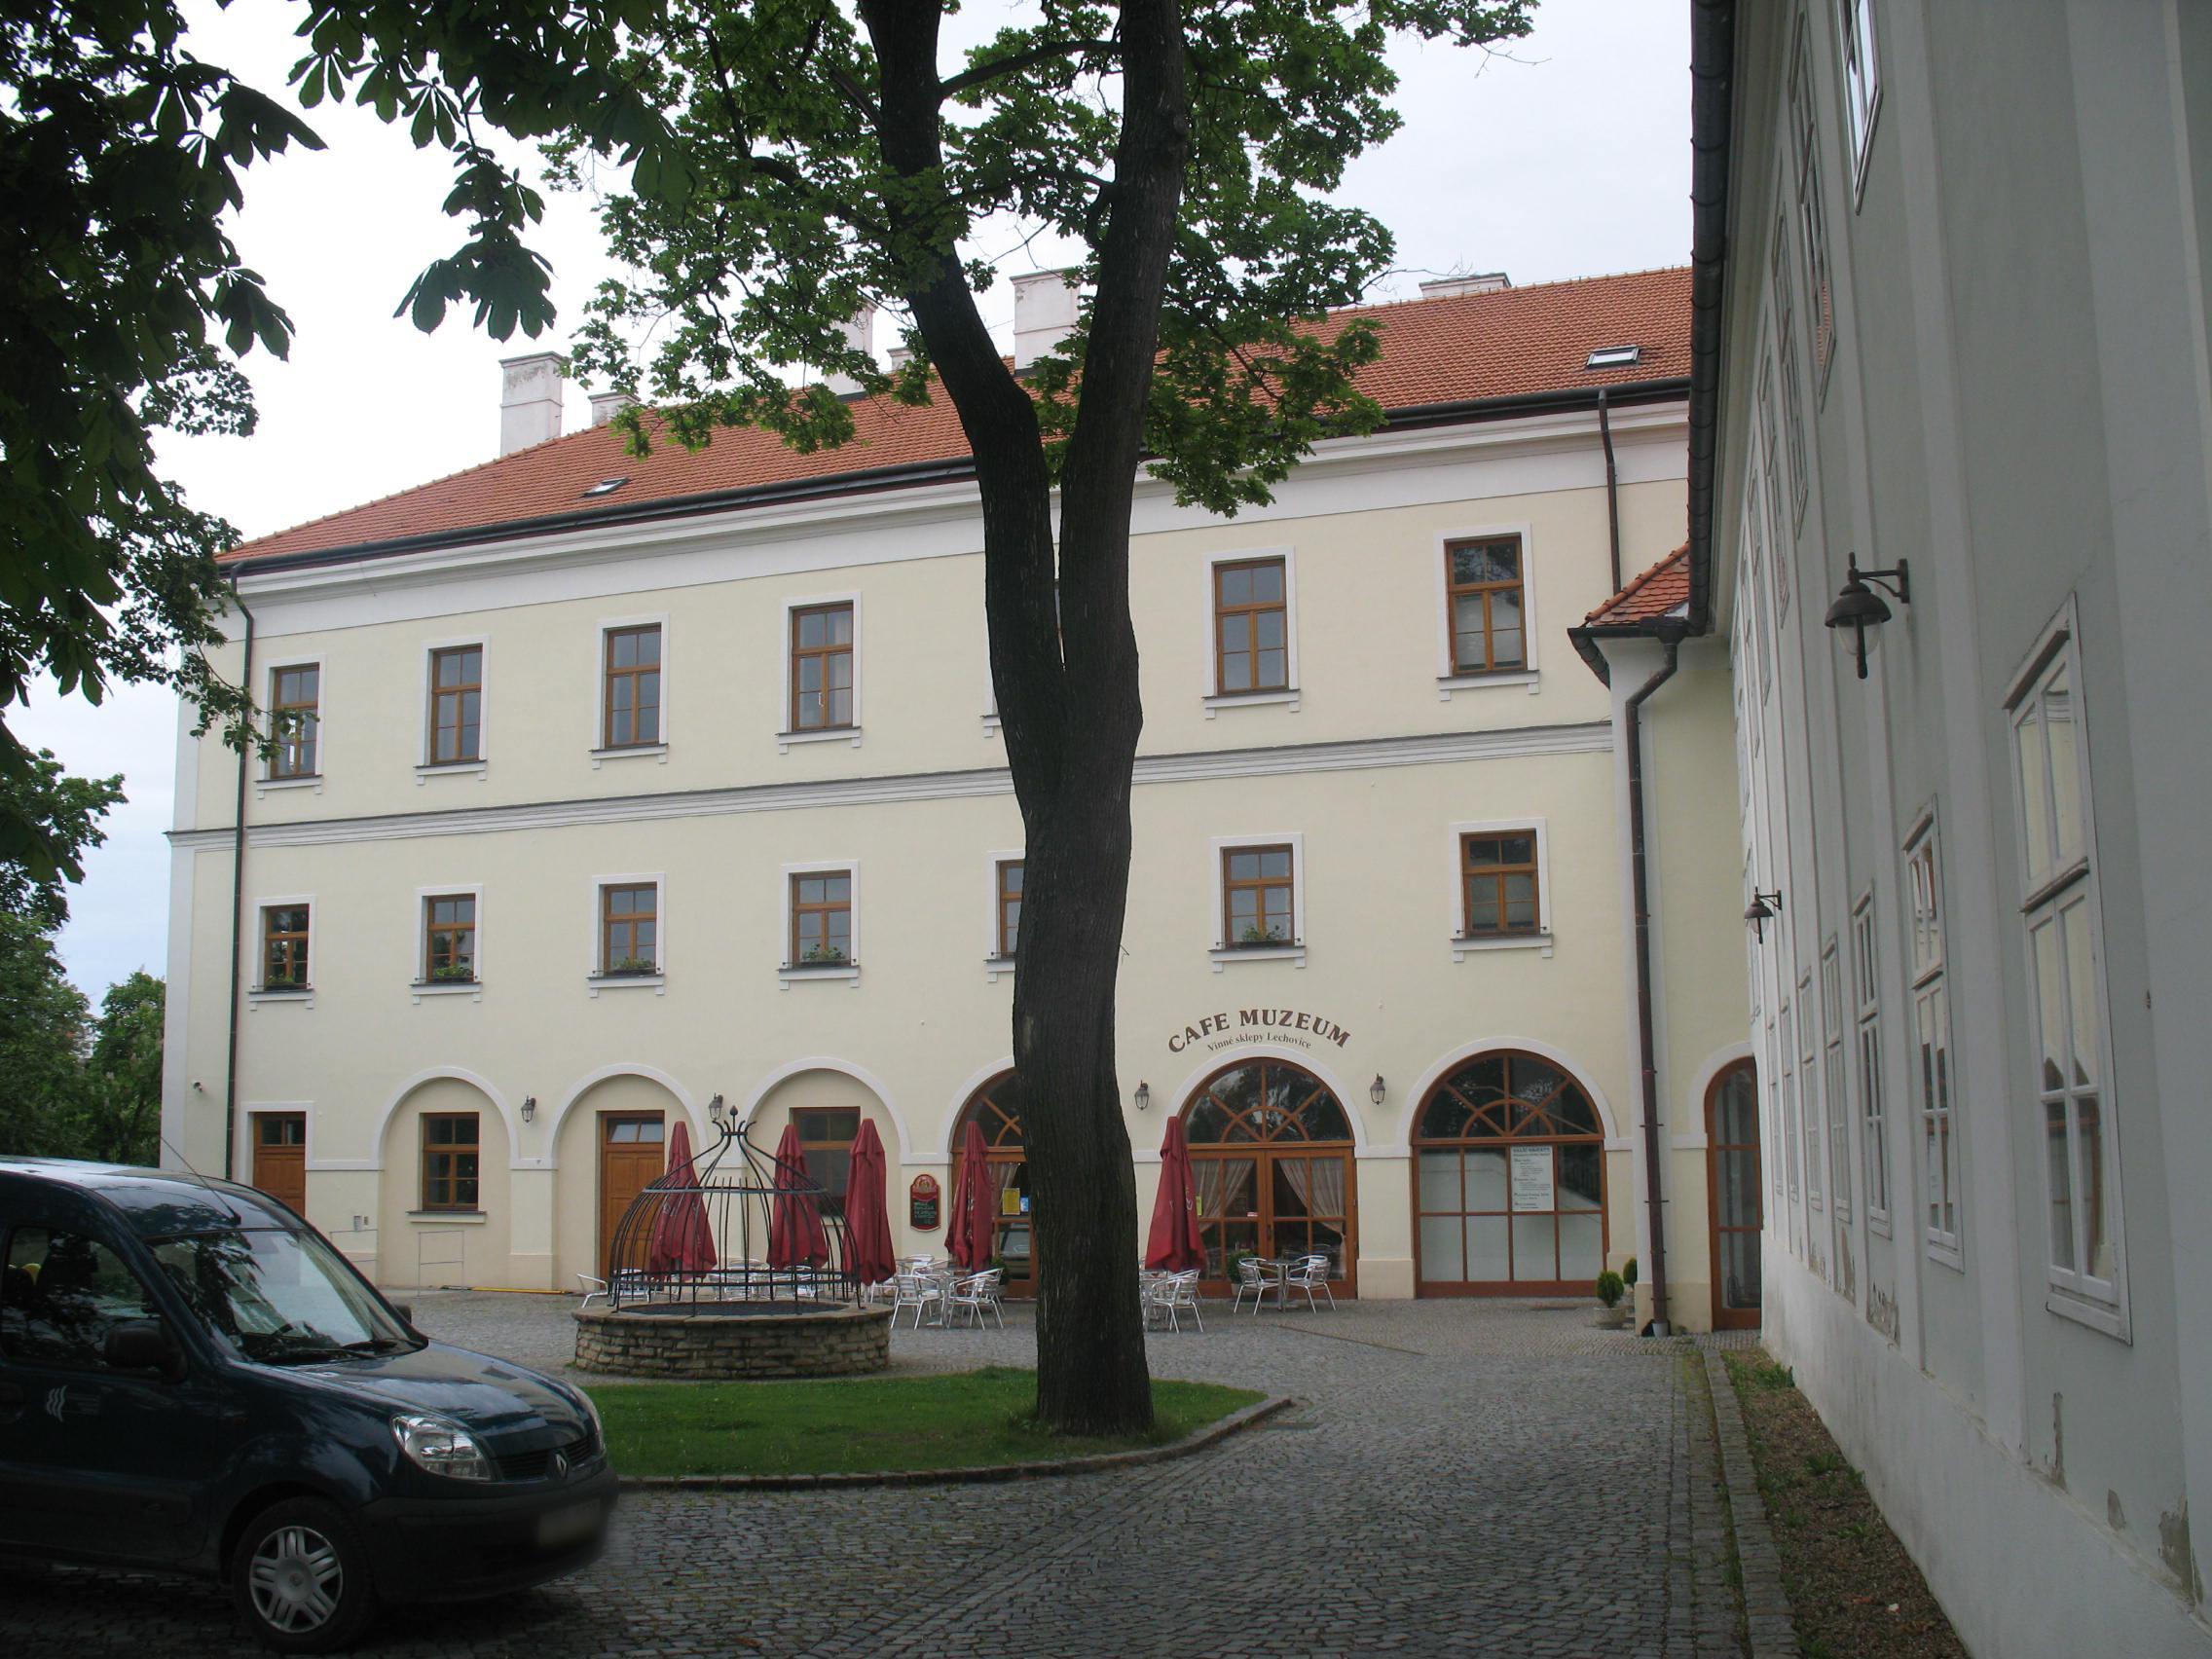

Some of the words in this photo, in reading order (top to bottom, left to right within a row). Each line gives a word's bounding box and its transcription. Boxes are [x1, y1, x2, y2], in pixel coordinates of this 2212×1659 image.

[1168, 1013, 1230, 1052] CAFE
[1238, 1009, 1350, 1048] MUZEUM
[1207, 1036, 1235, 1051] Vinné
[1235, 1032, 1264, 1044] sklepy
[1267, 1032, 1311, 1049] Lechovice
